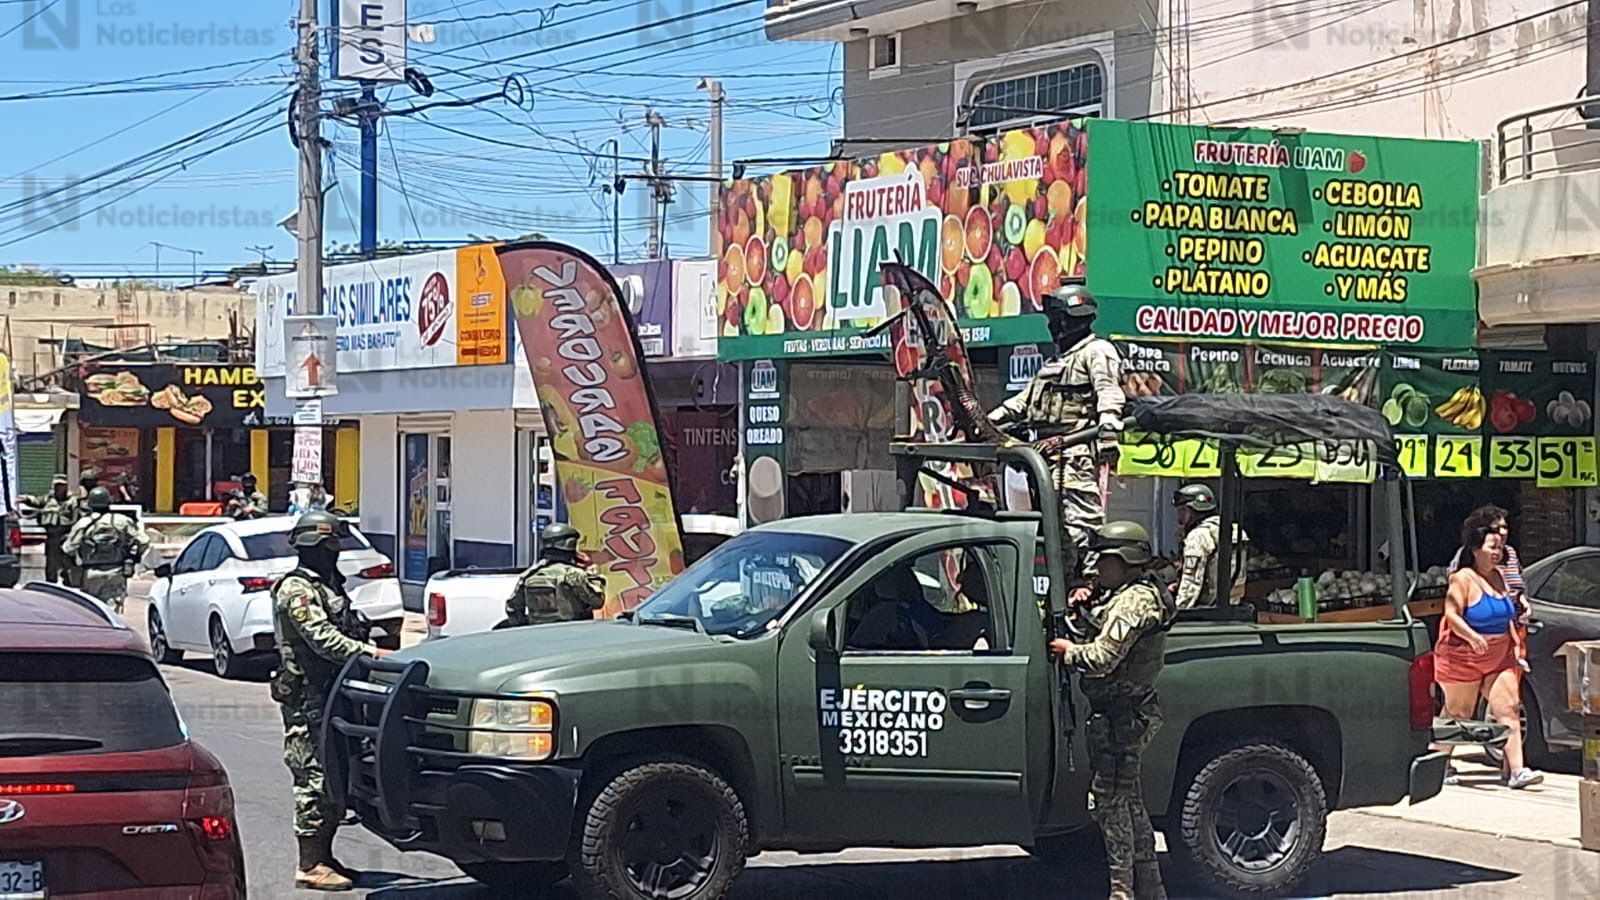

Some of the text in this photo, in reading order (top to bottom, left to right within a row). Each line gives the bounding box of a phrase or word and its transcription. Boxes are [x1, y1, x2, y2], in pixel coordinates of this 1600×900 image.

[1196, 140, 1344, 170] FRUTERÍA LIAM
[847, 176, 922, 220] FRUTERÍA
[1175, 173, 1268, 201] TOMATE
[1326, 182, 1421, 208] CEBOLLA
[1145, 203, 1297, 236] PAPA BLANCA
[1334, 209, 1410, 239] LIMÓN
[829, 217, 940, 309] LIAM
[1179, 238, 1263, 265] PEPINO
[1314, 244, 1430, 272] AGUACATE
[1167, 264, 1270, 296] PLÁTANO
[1337, 271, 1406, 301] Y MÁS
[349, 276, 412, 328] SIMILARES
[1138, 307, 1423, 342] CALIDAD Y MEJOR PRECIO
[184, 367, 264, 385] HAMB
[1011, 356, 1042, 379] LIAM
[1499, 361, 1533, 373] TOMATE
[233, 390, 265, 408] EX
[749, 405, 780, 424] QUESO
[746, 427, 783, 445] OREADO
[1440, 440, 1473, 473] 24
[1494, 439, 1534, 472] 33
[1540, 441, 1578, 479] 59
[820, 683, 947, 714] EJÉRCITO
[822, 711, 944, 731] MEXICANO
[839, 729, 928, 757] 3318351
